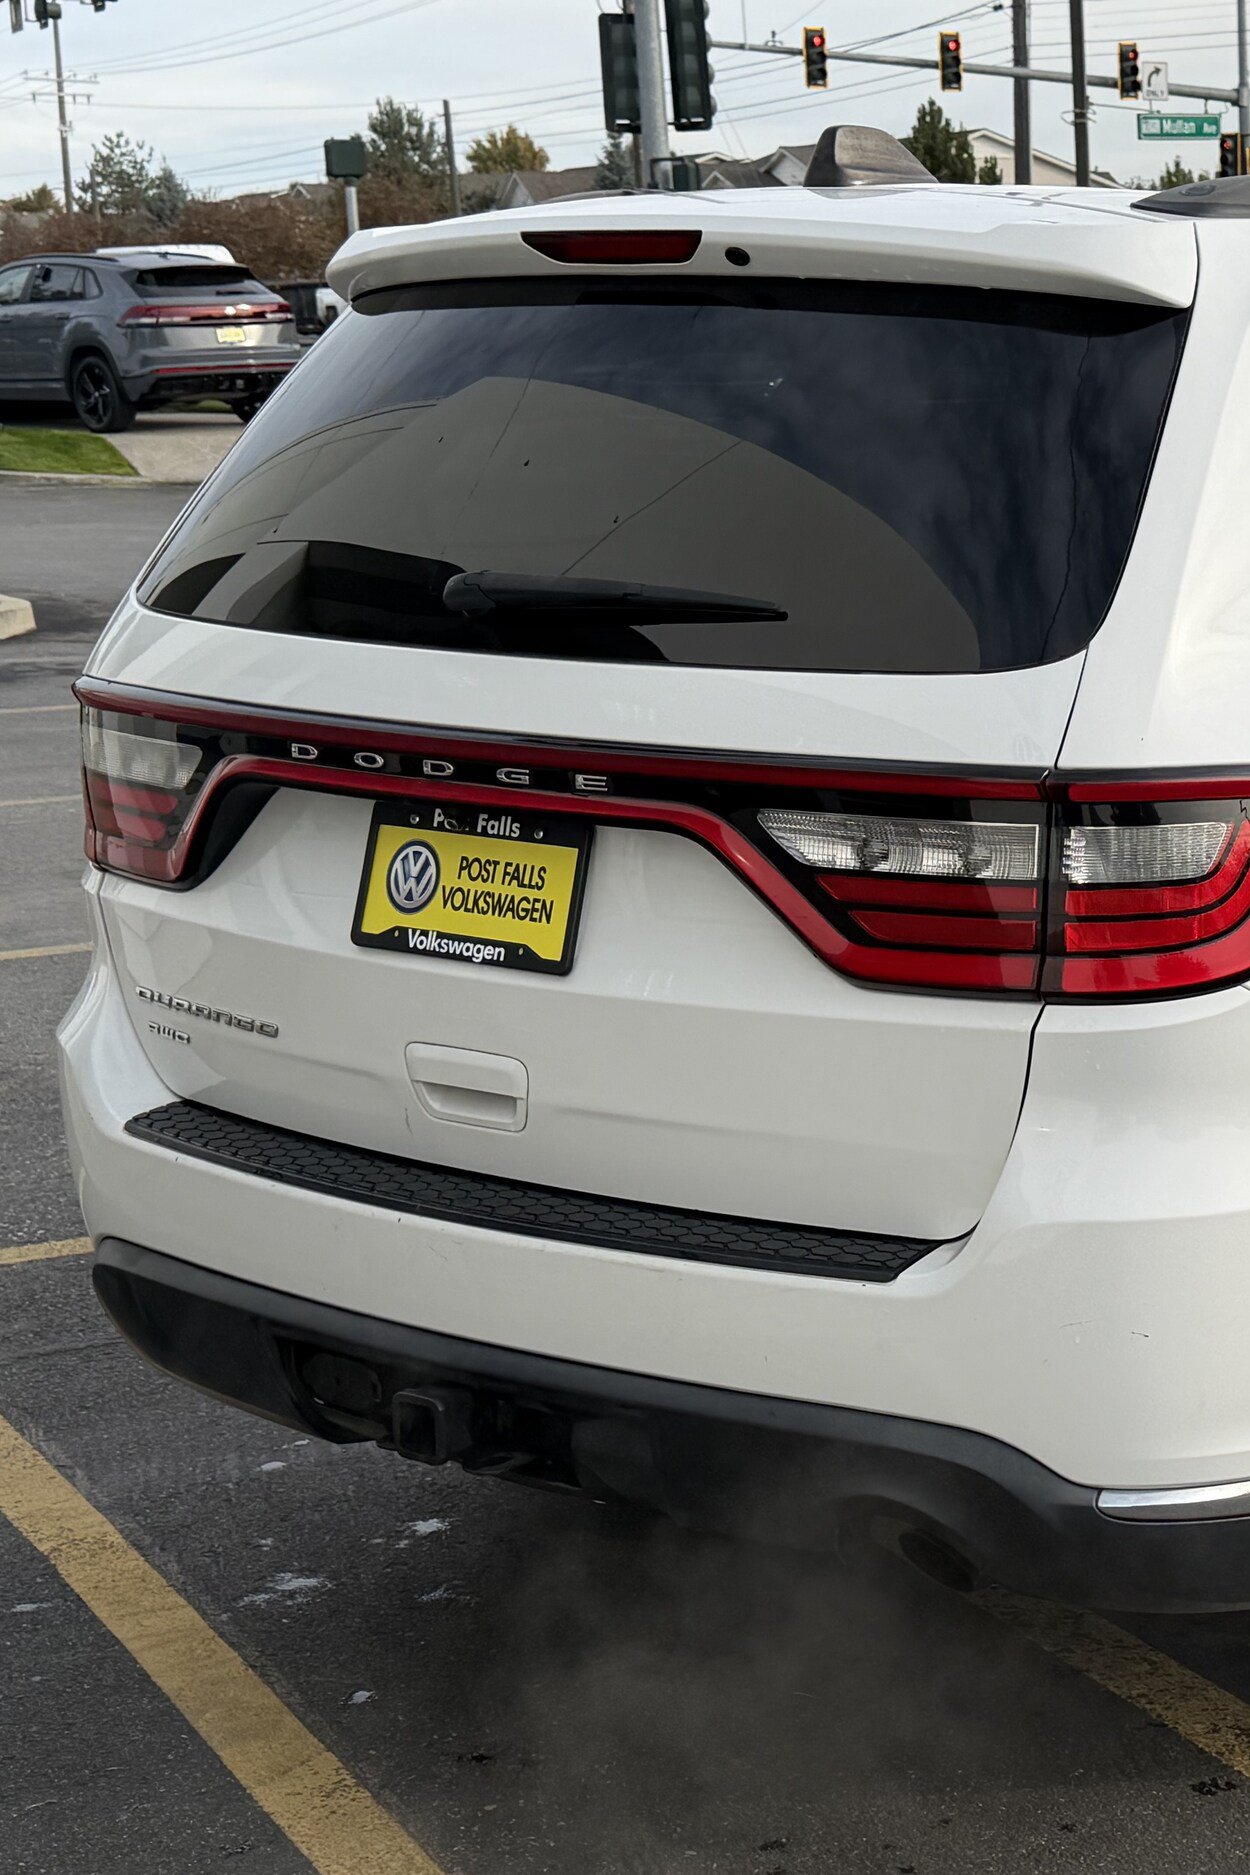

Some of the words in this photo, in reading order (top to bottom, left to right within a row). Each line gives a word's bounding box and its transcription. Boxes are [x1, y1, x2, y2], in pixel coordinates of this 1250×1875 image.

[1162, 119, 1196, 134] Mullan
[291, 743, 608, 792] DODGE
[476, 813, 521, 838] Falls
[457, 856, 500, 884] POST
[501, 861, 547, 891] FALLS
[441, 885, 555, 925] VOLKSWAGEN
[408, 928, 505, 963] Volkswagen
[135, 985, 279, 1038] DURANGO
